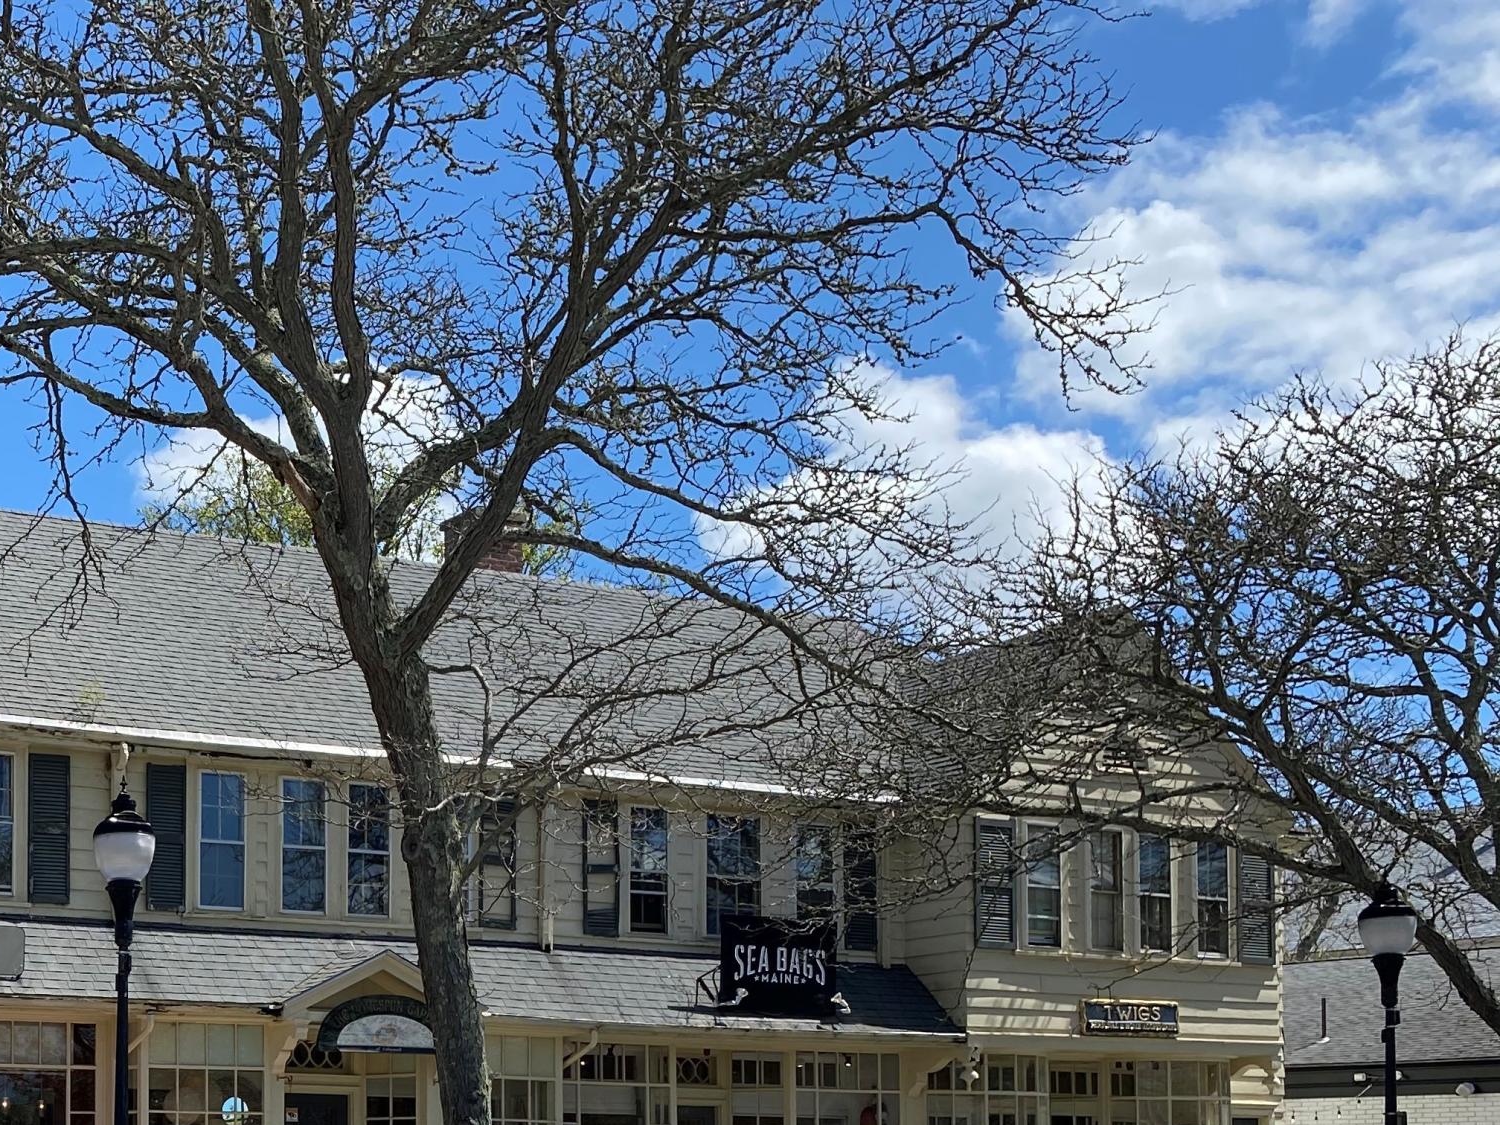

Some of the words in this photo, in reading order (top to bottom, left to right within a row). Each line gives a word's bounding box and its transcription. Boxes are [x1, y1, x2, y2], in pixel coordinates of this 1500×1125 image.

[733, 944, 770, 981] SEA
[776, 946, 826, 986] BAGS
[761, 973, 800, 985] MAINE
[1103, 1005, 1161, 1021] TWIGS
